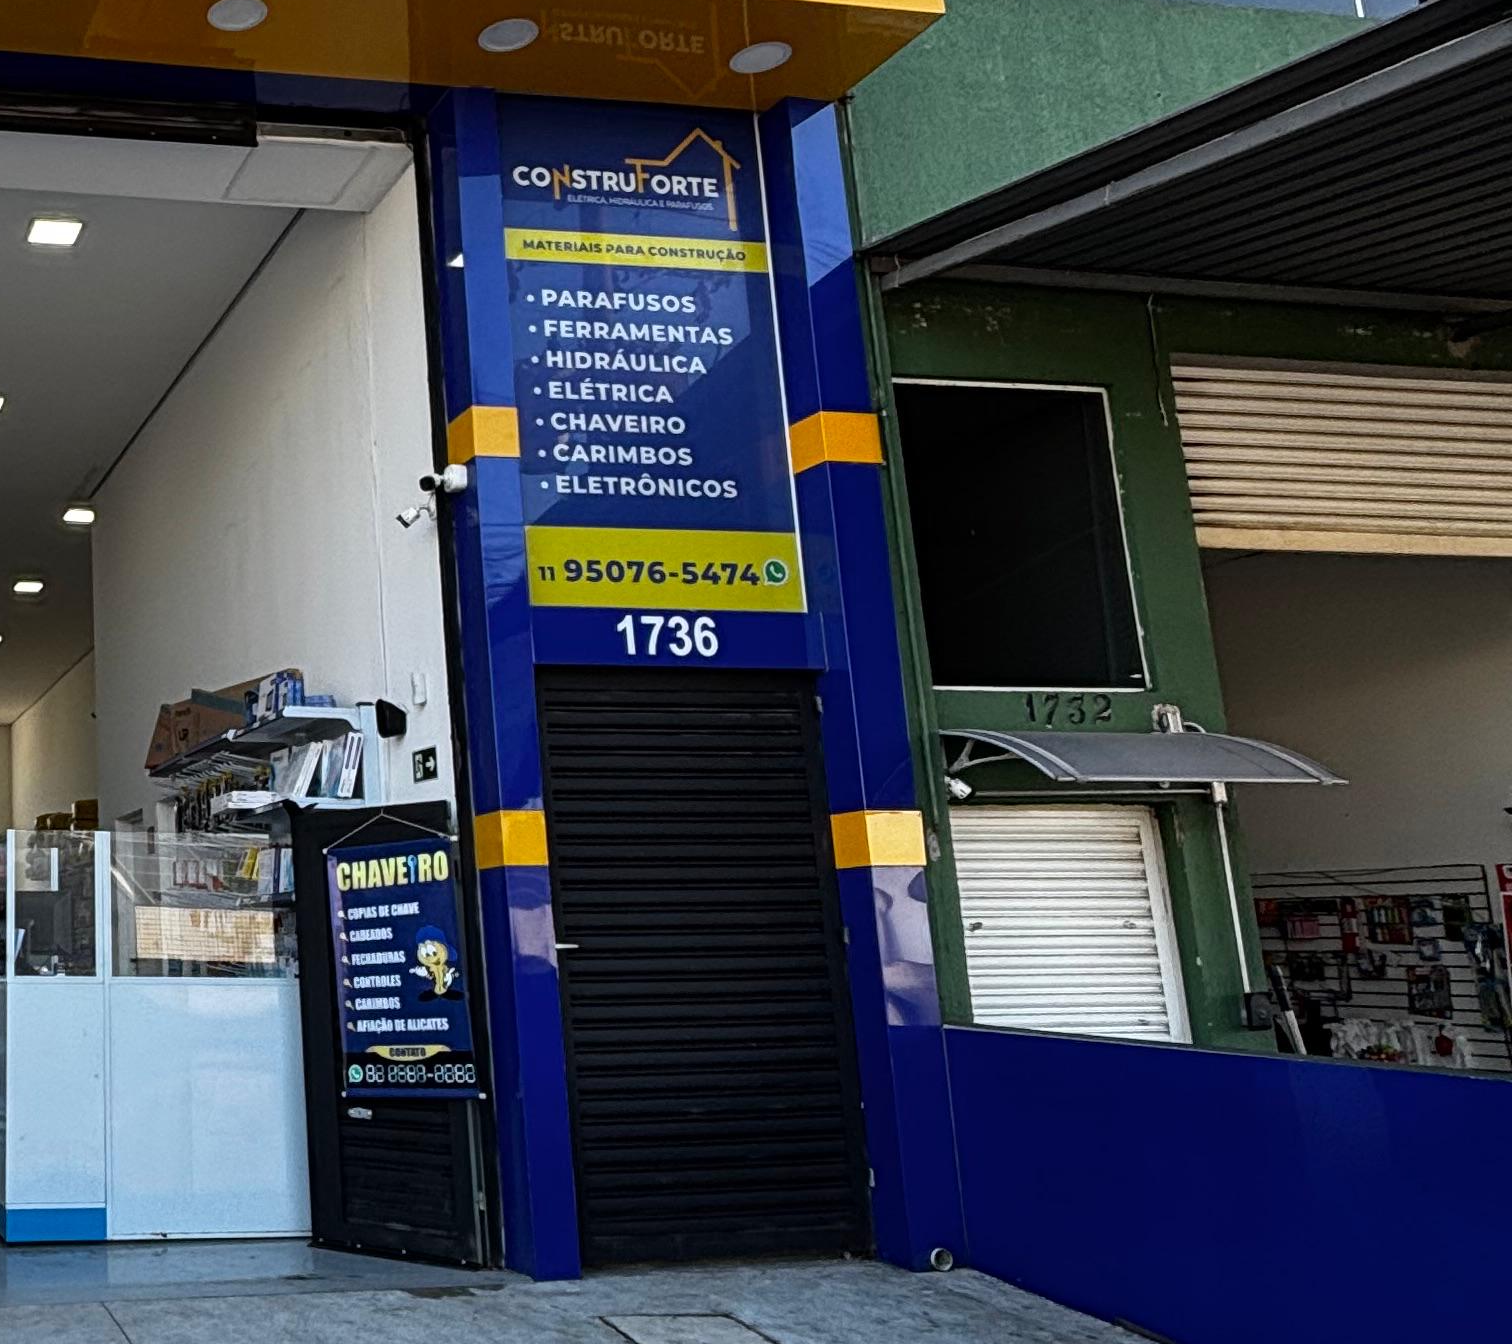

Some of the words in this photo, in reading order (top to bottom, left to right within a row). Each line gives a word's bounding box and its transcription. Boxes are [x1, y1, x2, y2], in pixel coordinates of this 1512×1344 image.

[512, 161, 720, 199] CONSTRUFORTE
[522, 239, 602, 253] MATERIAIS
[606, 243, 646, 256] PARA
[648, 245, 746, 263] CONSTRUÇÃO
[541, 289, 696, 314] PARAFUSOS
[544, 319, 734, 346] FERRAMENTAS
[546, 346, 707, 374] HIDRÁULICA
[548, 376, 674, 404] ELÉTRICA
[550, 411, 687, 436] CHAVEIRO
[553, 441, 694, 467] CARIMBOS
[555, 470, 738, 499] ELETRÔNICOS
[538, 564, 556, 582] 11
[563, 558, 761, 587] 95076-5474
[616, 614, 719, 657] 1736
[1025, 693, 1113, 725] 1732
[378, 905, 390, 917] DE
[391, 902, 420, 916] CHAVE
[351, 950, 406, 965] FECHADURAS
[353, 975, 402, 988] CONTROLES
[355, 997, 401, 1010] CARIMBOS
[357, 1017, 393, 1034] AFIAÇÃO
[394, 1019, 406, 1031] DE
[407, 1018, 449, 1031] ALICATES
[389, 1047, 427, 1057] CONTATO
